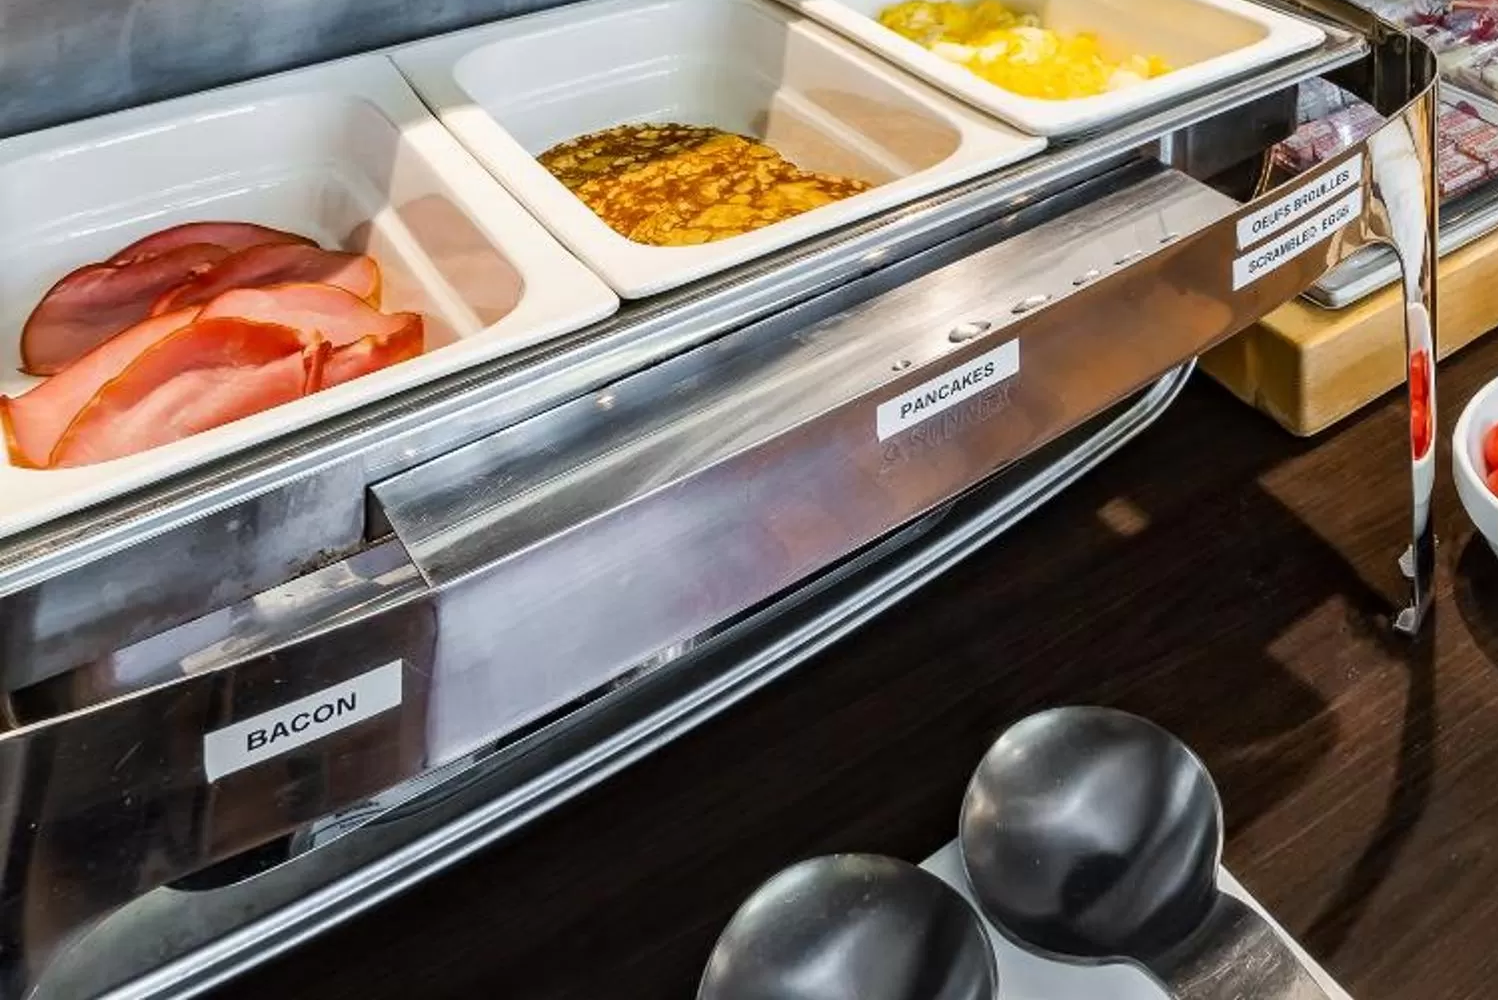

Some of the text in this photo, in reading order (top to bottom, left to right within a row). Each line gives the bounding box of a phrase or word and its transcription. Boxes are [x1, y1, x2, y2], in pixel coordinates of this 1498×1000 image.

[1249, 205, 1350, 273] SCRAMBLED EGGS
[900, 361, 995, 419] PANCAKES
[247, 692, 357, 751] BACON
